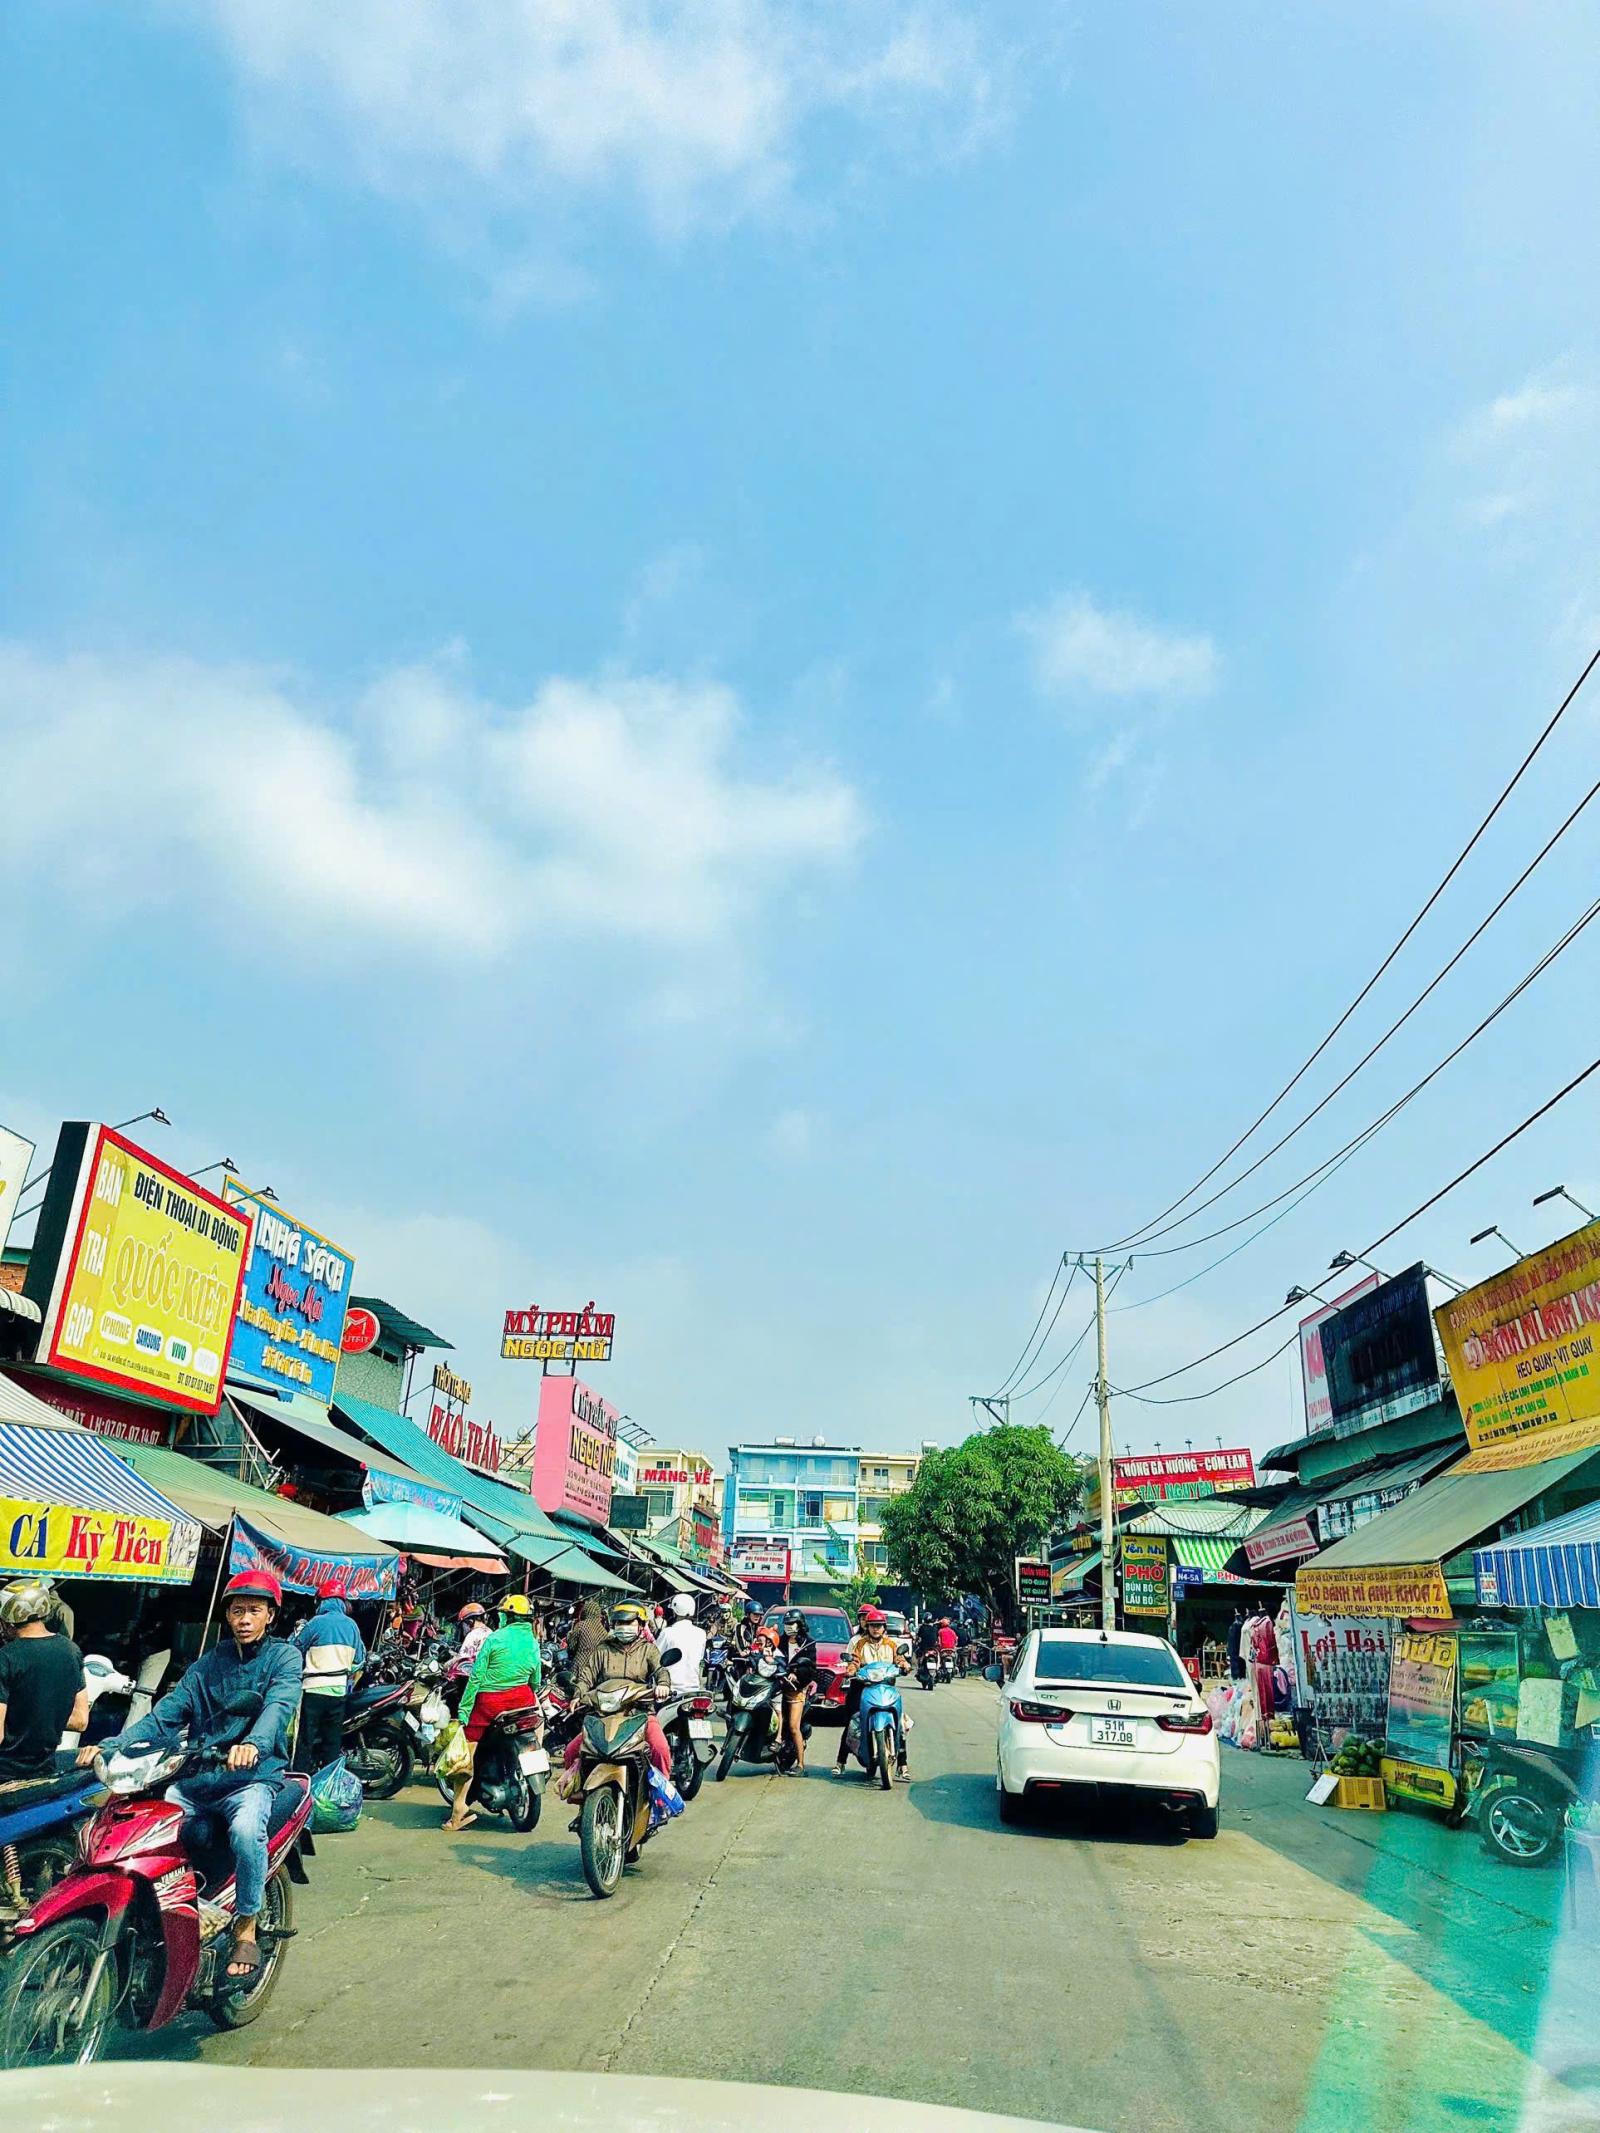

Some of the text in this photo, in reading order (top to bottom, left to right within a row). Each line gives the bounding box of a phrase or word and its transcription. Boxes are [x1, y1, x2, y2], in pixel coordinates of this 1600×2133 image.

[95, 1156, 124, 1208] BÁN
[134, 1172, 239, 1252] ĐIỆN THOẠI DI ĐỘNG
[82, 1224, 110, 1277] TRẢ
[301, 1240, 346, 1292] SÁCH
[112, 1232, 229, 1344] QUỐC KIỆT
[65, 1297, 93, 1348] GÓP
[101, 1316, 130, 1340] IPHONE
[505, 1301, 613, 1337] MỸ PHẨM
[136, 1328, 161, 1351] SAMSUNG
[171, 1342, 187, 1361] VIVO
[504, 1338, 608, 1363] NGỌC NỮ
[1516, 1362, 1532, 1379] HEO
[1532, 1351, 1554, 1373] QUAY
[1556, 1345, 1570, 1366] VỊT
[1571, 1336, 1594, 1359] QUAY
[451, 1375, 472, 1404] TRANG
[465, 1420, 501, 1473] TRÂN
[1150, 1457, 1165, 1475] GÀ
[1166, 1454, 1198, 1473] NƯỚNG
[1204, 1452, 1226, 1471] CƠM
[1228, 1454, 1247, 1469] LAM
[644, 1468, 688, 1484] MANG
[1165, 1478, 1214, 1500] NGUYÊN
[9, 1507, 162, 1573] CÁ Kỳ Tiên
[1125, 1543, 1143, 1554] Yên
[1125, 1560, 1165, 1581] PHỞ
[1178, 1573, 1200, 1581] N4-5A
[1125, 1581, 1141, 1592] BÚN
[1344, 1629, 1386, 1653] Hải
[1097, 1730, 1133, 1743] 317.08
[160, 1865, 186, 1885] YAMAHA
